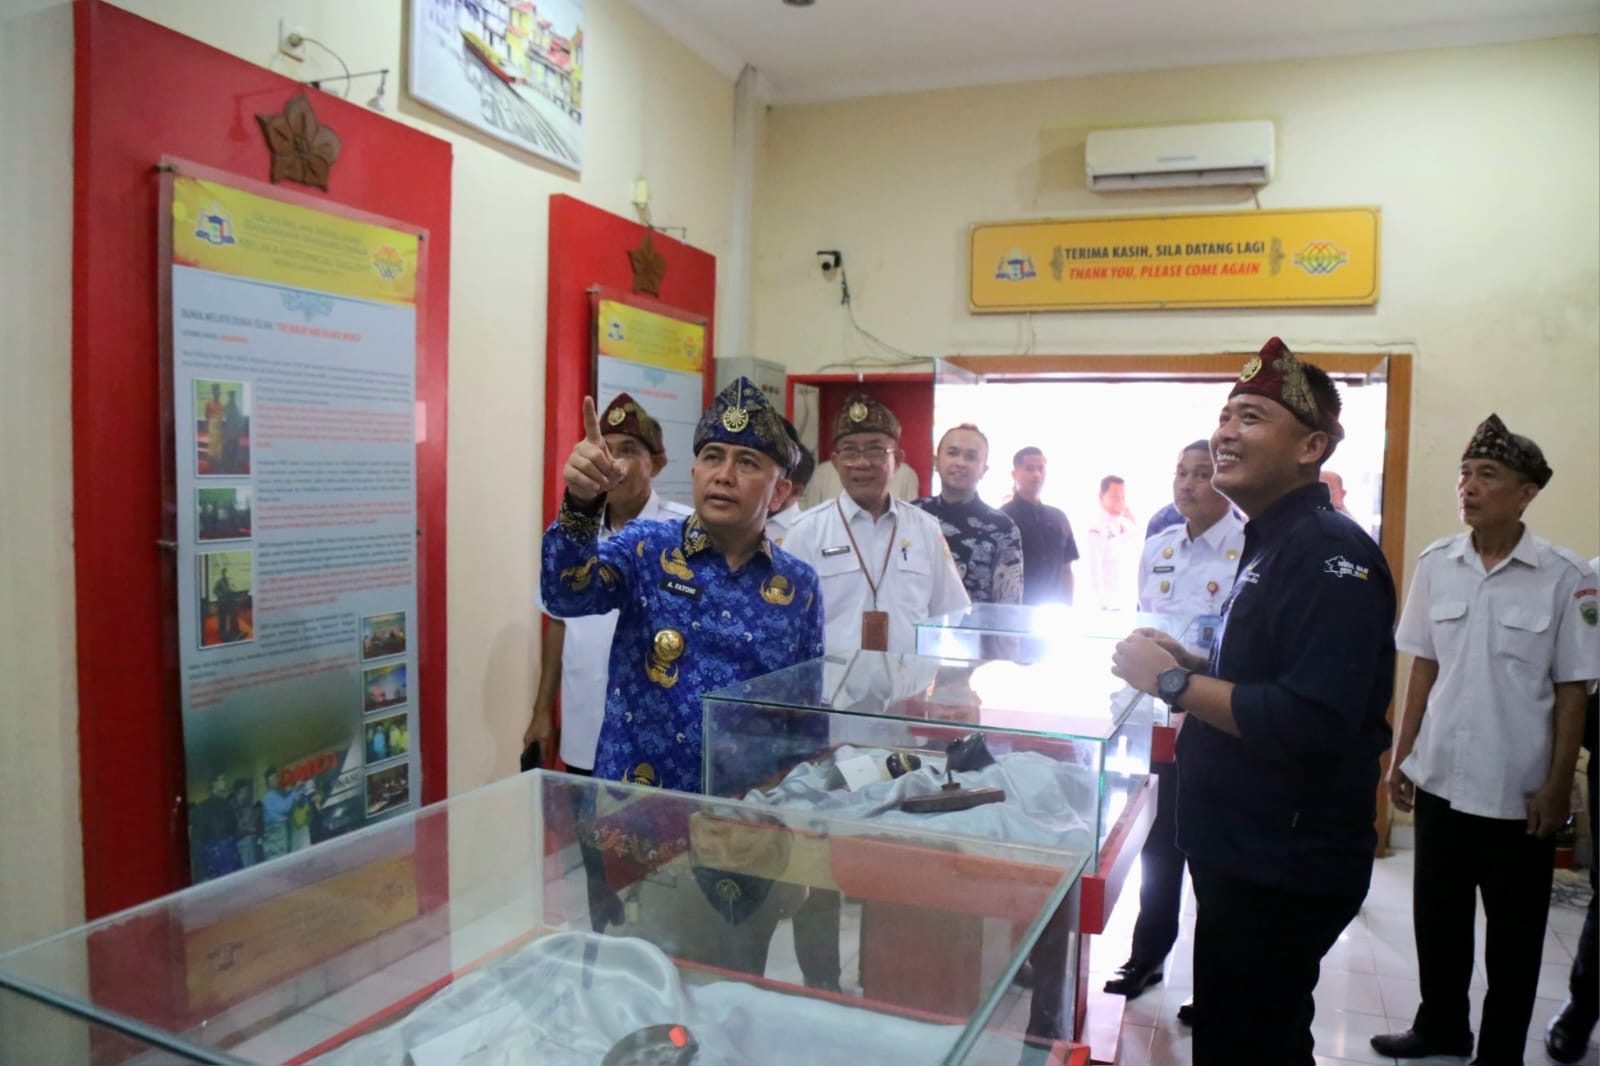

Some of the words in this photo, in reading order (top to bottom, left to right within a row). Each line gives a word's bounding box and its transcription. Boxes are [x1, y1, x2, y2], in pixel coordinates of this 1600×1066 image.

[1065, 247, 1109, 260] TERIMA
[1112, 245, 1152, 258] KASIH,
[1156, 244, 1182, 257] SILA
[1186, 242, 1233, 255] DATANG
[1237, 241, 1265, 254] LAGI
[1070, 267, 1107, 280] THANK
[1111, 265, 1136, 280] YOU,
[1140, 264, 1181, 278] PLEASE
[1185, 264, 1217, 276] COME
[1221, 263, 1260, 275] AGAIN
